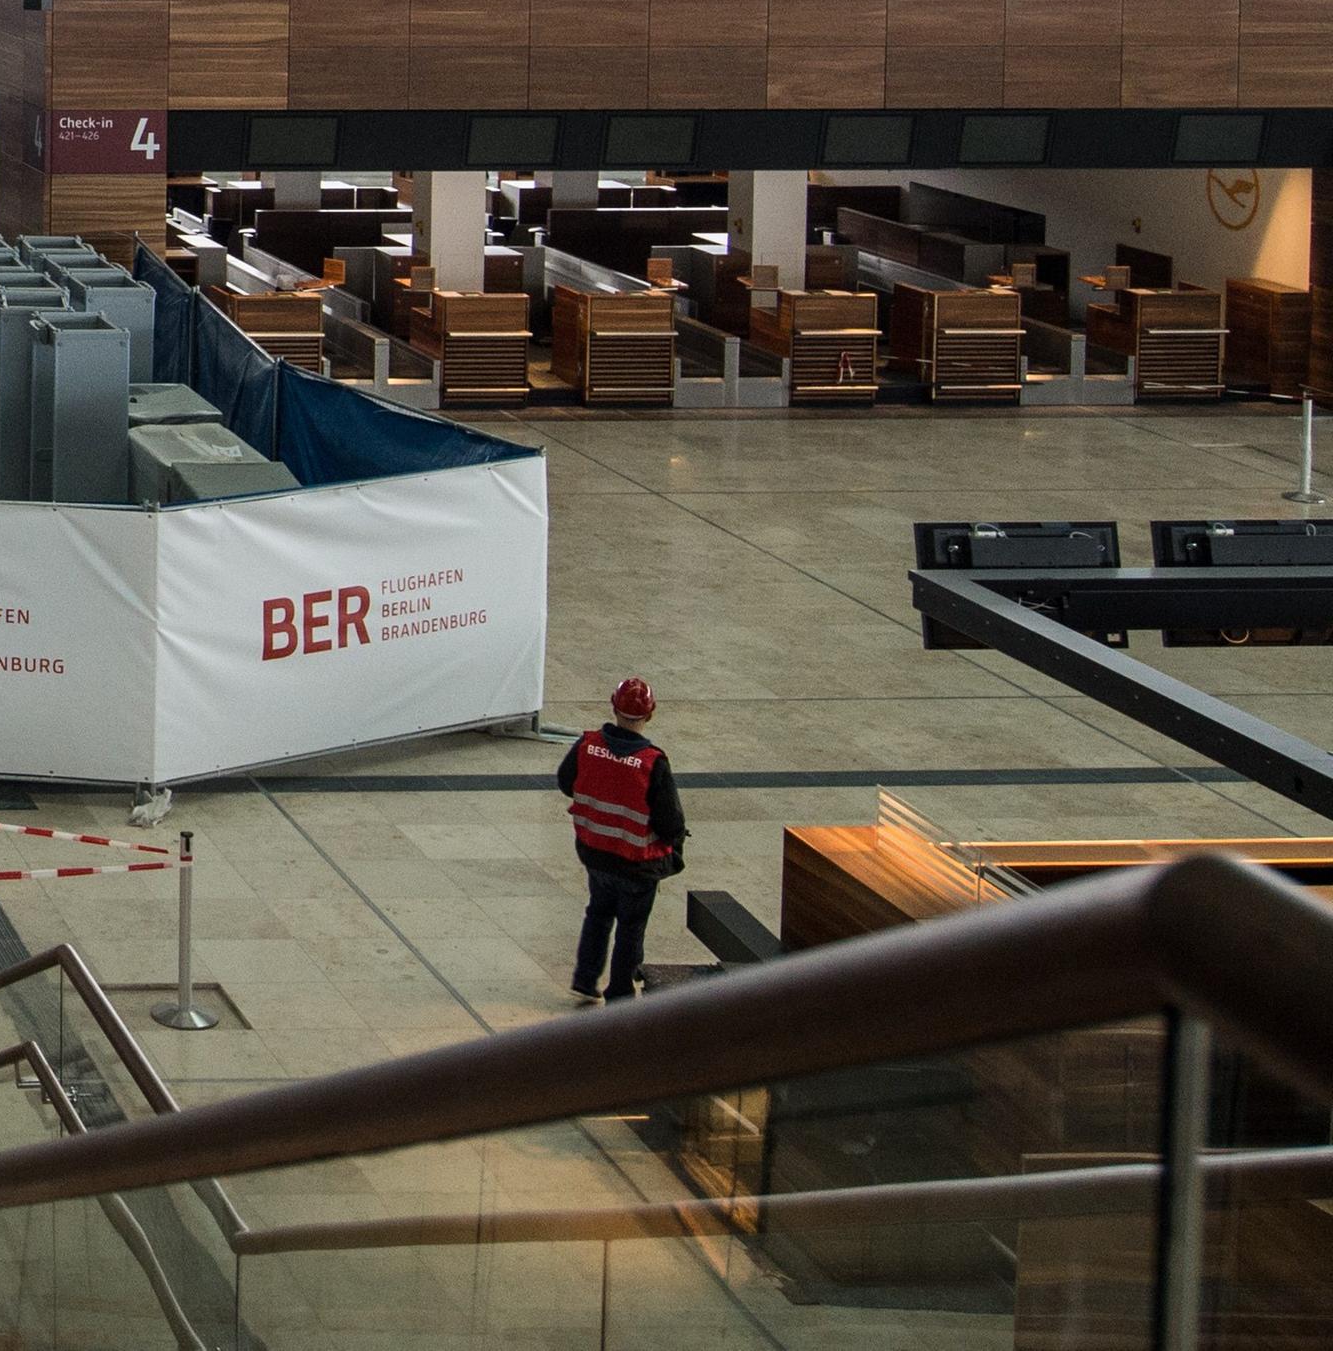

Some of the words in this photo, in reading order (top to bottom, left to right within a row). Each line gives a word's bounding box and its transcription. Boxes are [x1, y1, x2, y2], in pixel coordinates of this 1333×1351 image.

[59, 116, 113, 129] Check-in
[130, 117, 160, 160] 4
[381, 568, 463, 595] FLUGHAFEN
[381, 597, 431, 617] BERLIN
[262, 585, 371, 661] BER
[381, 610, 487, 641] BRANDENBURG
